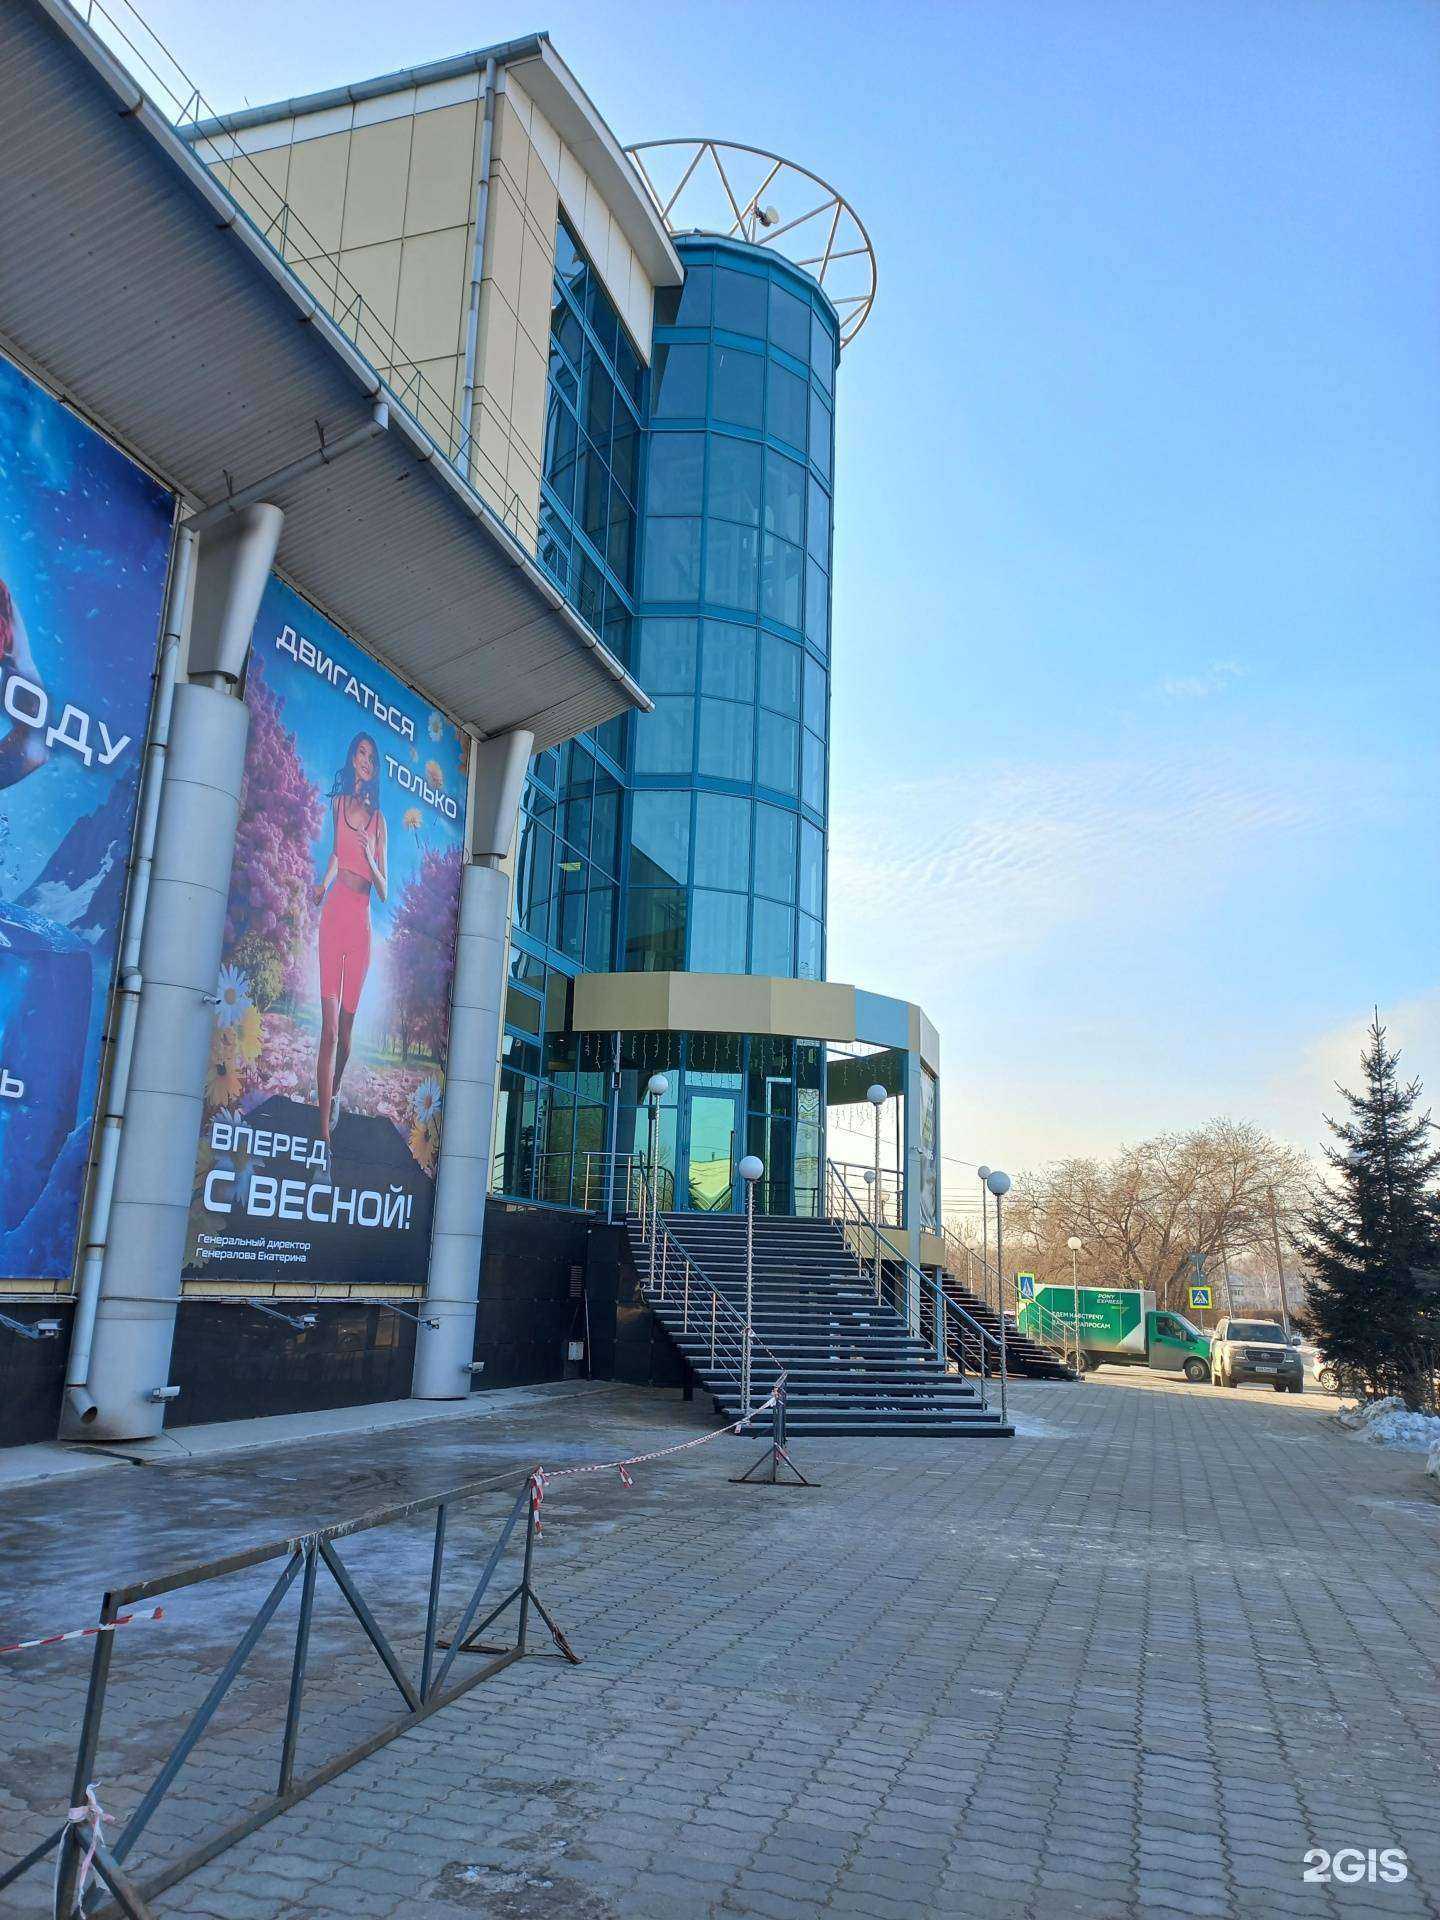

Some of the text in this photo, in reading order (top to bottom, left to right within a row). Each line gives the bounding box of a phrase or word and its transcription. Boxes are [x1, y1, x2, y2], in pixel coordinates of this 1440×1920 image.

[275, 624, 415, 742] ДВИГАТЬСЯ
[0, 667, 132, 767] ОДУ
[385, 754, 457, 819] ТОЛЬКО
[211, 1122, 327, 1171] ВПЕРЕД
[203, 1169, 413, 1230] С ВЕСНОЙ!
[195, 1247, 307, 1263] Генералова Екатерина
[197, 1233, 311, 1252] Генеральный директор
